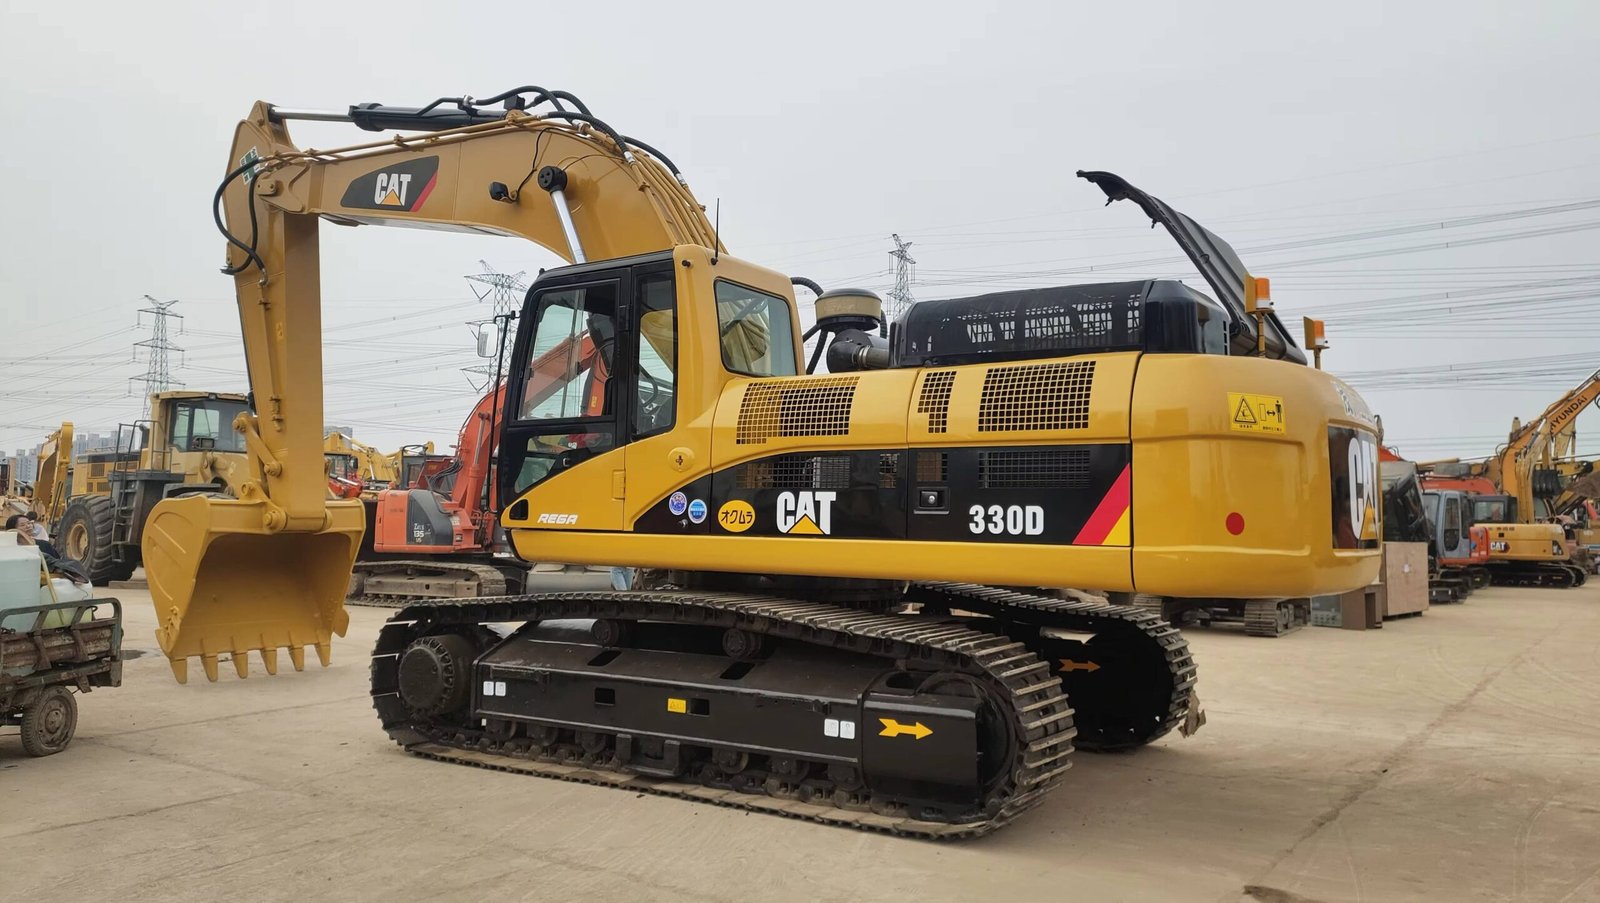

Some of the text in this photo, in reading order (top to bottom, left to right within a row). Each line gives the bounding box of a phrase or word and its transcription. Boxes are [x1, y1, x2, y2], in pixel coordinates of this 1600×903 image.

[374, 173, 412, 206] CAT
[537, 513, 578, 525] REGA
[721, 509, 753, 525] オクムラ
[776, 491, 837, 535] CAT
[969, 504, 1044, 535] 330D
[1490, 541, 1506, 551] CAT
